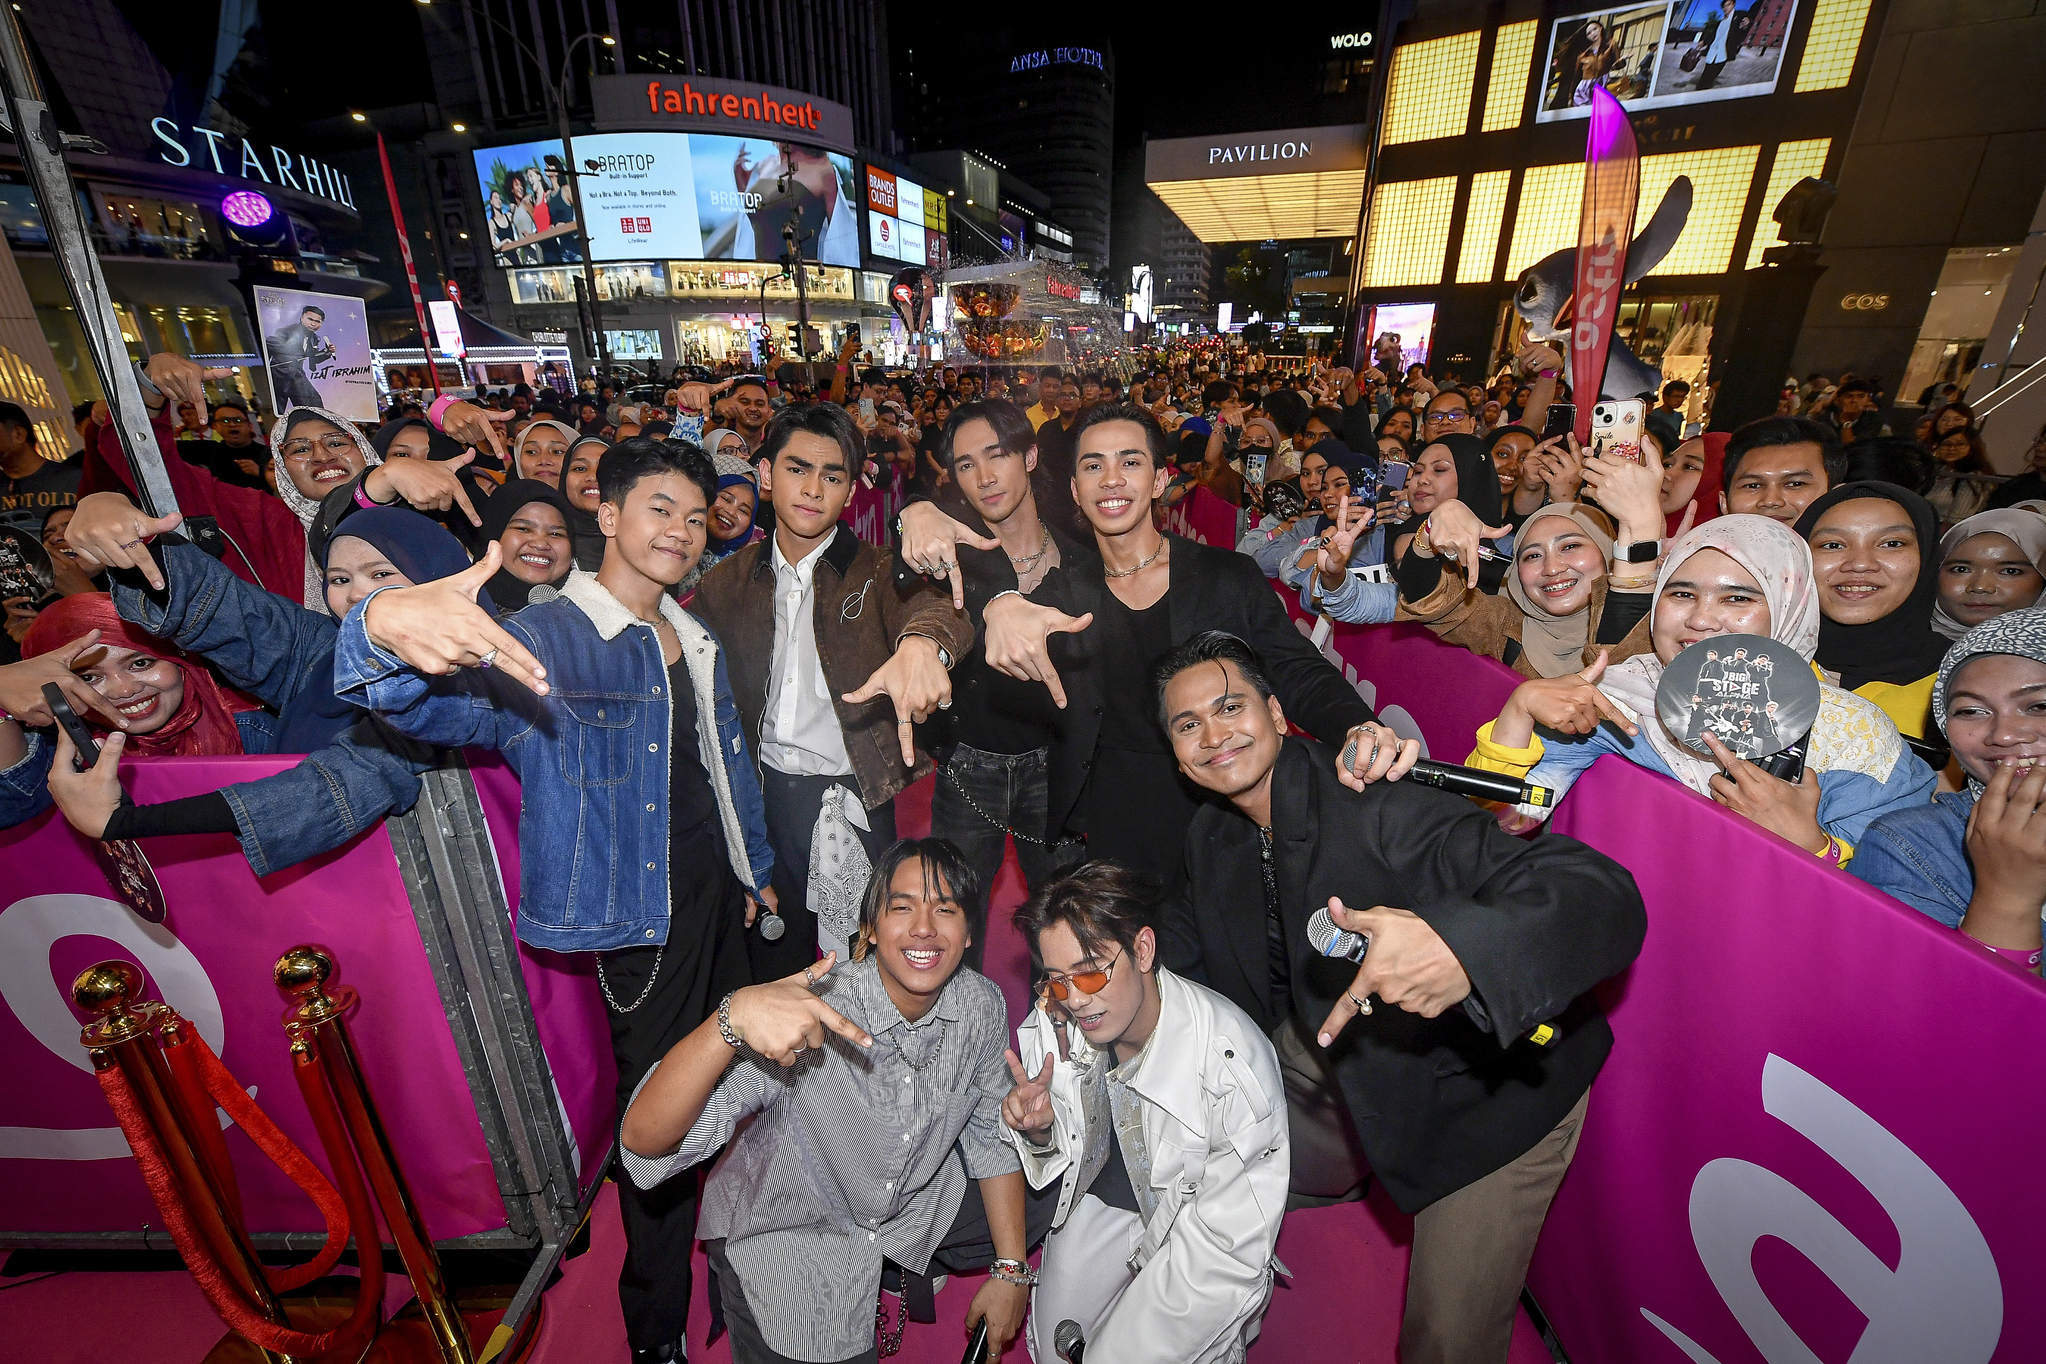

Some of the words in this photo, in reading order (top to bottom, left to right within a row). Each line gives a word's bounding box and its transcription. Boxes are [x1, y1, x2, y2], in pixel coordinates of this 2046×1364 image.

[1330, 32, 1372, 49] WOLO
[1010, 50, 1050, 73] ANSA
[1054, 47, 1104, 70] HOTEL
[1208, 141, 1313, 164] PAVILION
[151, 117, 357, 211] STARHILL
[598, 154, 655, 172] BRATOP
[869, 174, 895, 195] BRANDS
[640, 190, 661, 198] Beyond
[710, 190, 763, 208] BRATOP
[871, 189, 895, 208] OUTLET
[1841, 293, 1890, 310] COS
[310, 365, 334, 380] IZAT
[332, 365, 370, 378] IBRAHIM
[1594, 432, 1613, 440] Smile
[1728, 672, 1746, 682] BIG
